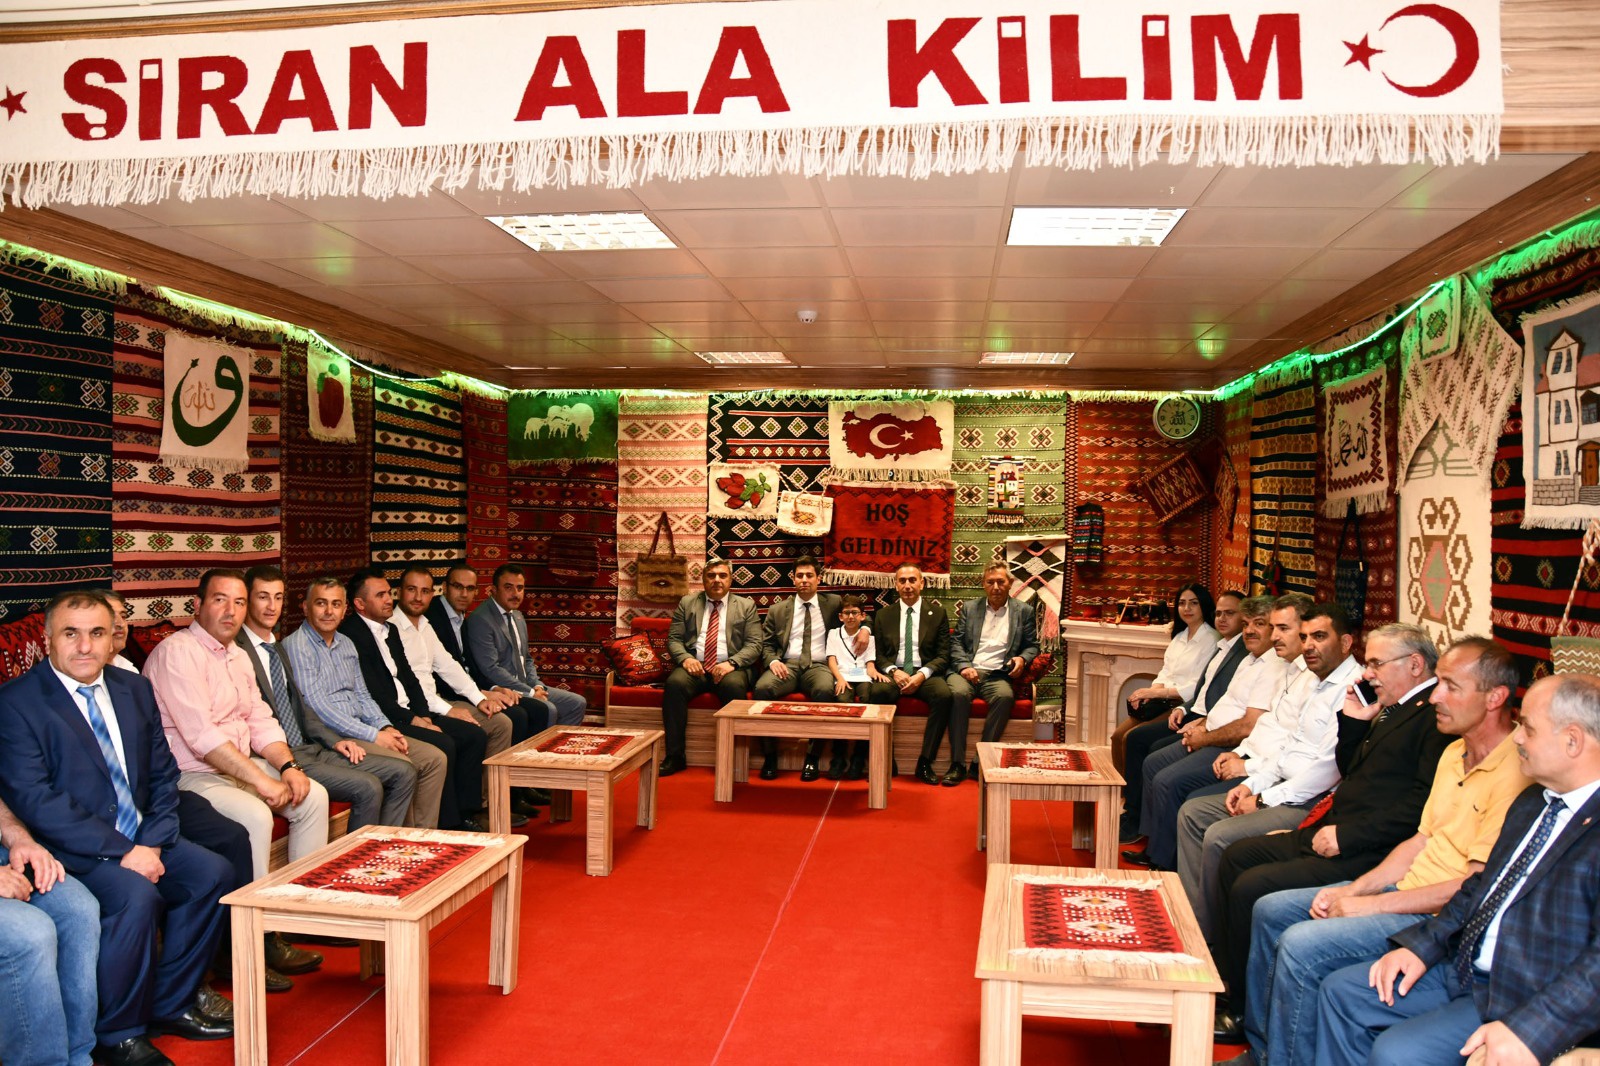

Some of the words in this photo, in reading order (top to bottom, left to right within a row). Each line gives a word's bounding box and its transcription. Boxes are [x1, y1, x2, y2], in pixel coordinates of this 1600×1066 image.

[514, 26, 791, 122] ALA
[887, 13, 1303, 108] KİLİM
[866, 503, 909, 527] HOŞ
[840, 536, 939, 557] GELDİNİZ
